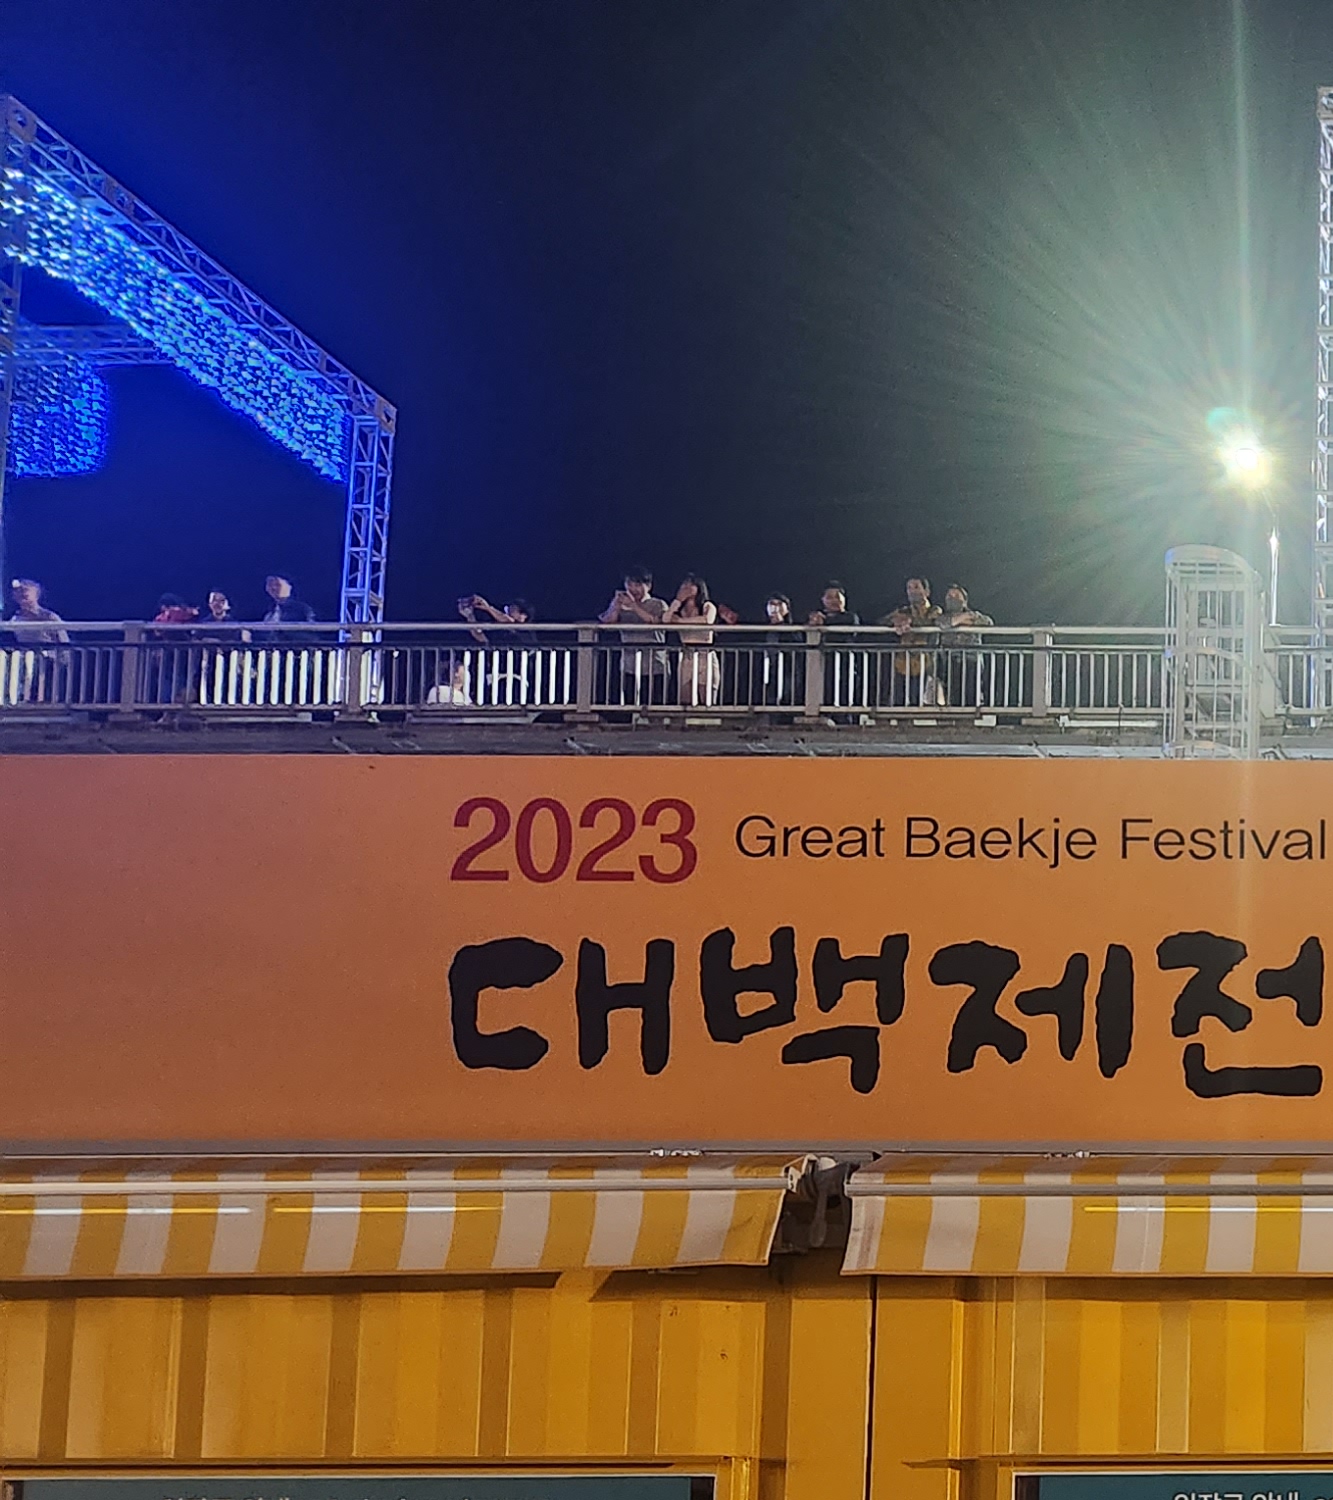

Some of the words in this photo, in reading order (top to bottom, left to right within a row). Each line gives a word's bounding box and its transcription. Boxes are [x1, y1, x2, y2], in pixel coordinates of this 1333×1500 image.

[449, 796, 698, 886] 2023
[735, 814, 886, 859] Great
[905, 816, 1098, 869] Baekje
[1121, 817, 1327, 861] Festival
[447, 925, 1325, 1099] 대백제전
